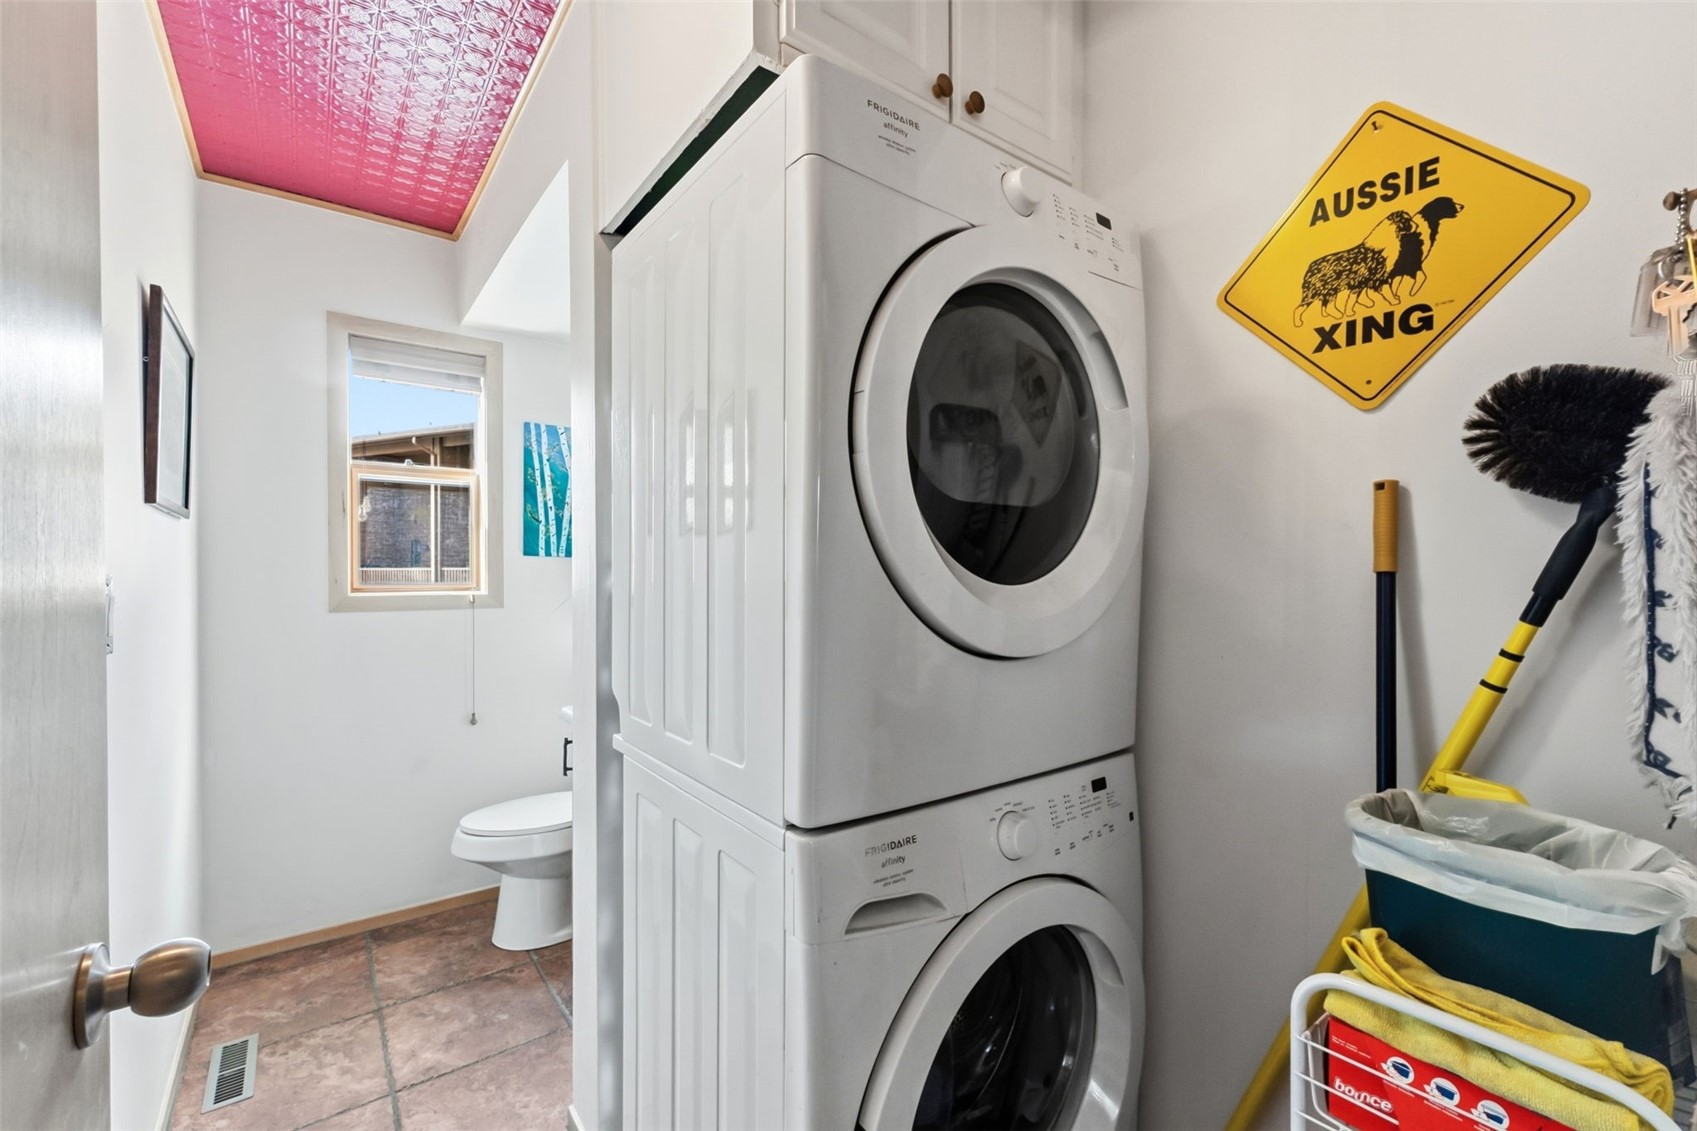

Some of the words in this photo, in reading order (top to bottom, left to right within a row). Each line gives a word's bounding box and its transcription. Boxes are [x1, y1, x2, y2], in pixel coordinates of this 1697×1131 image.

[867, 99, 921, 131] FRIGIDAIRE
[883, 122, 909, 138] affinity
[1309, 156, 1440, 227] AUSSIE
[1311, 303, 1434, 354] XING
[864, 834, 918, 857] FRIGIDAIRE
[881, 855, 906, 868] affinity
[1334, 1078, 1393, 1112] bounce
